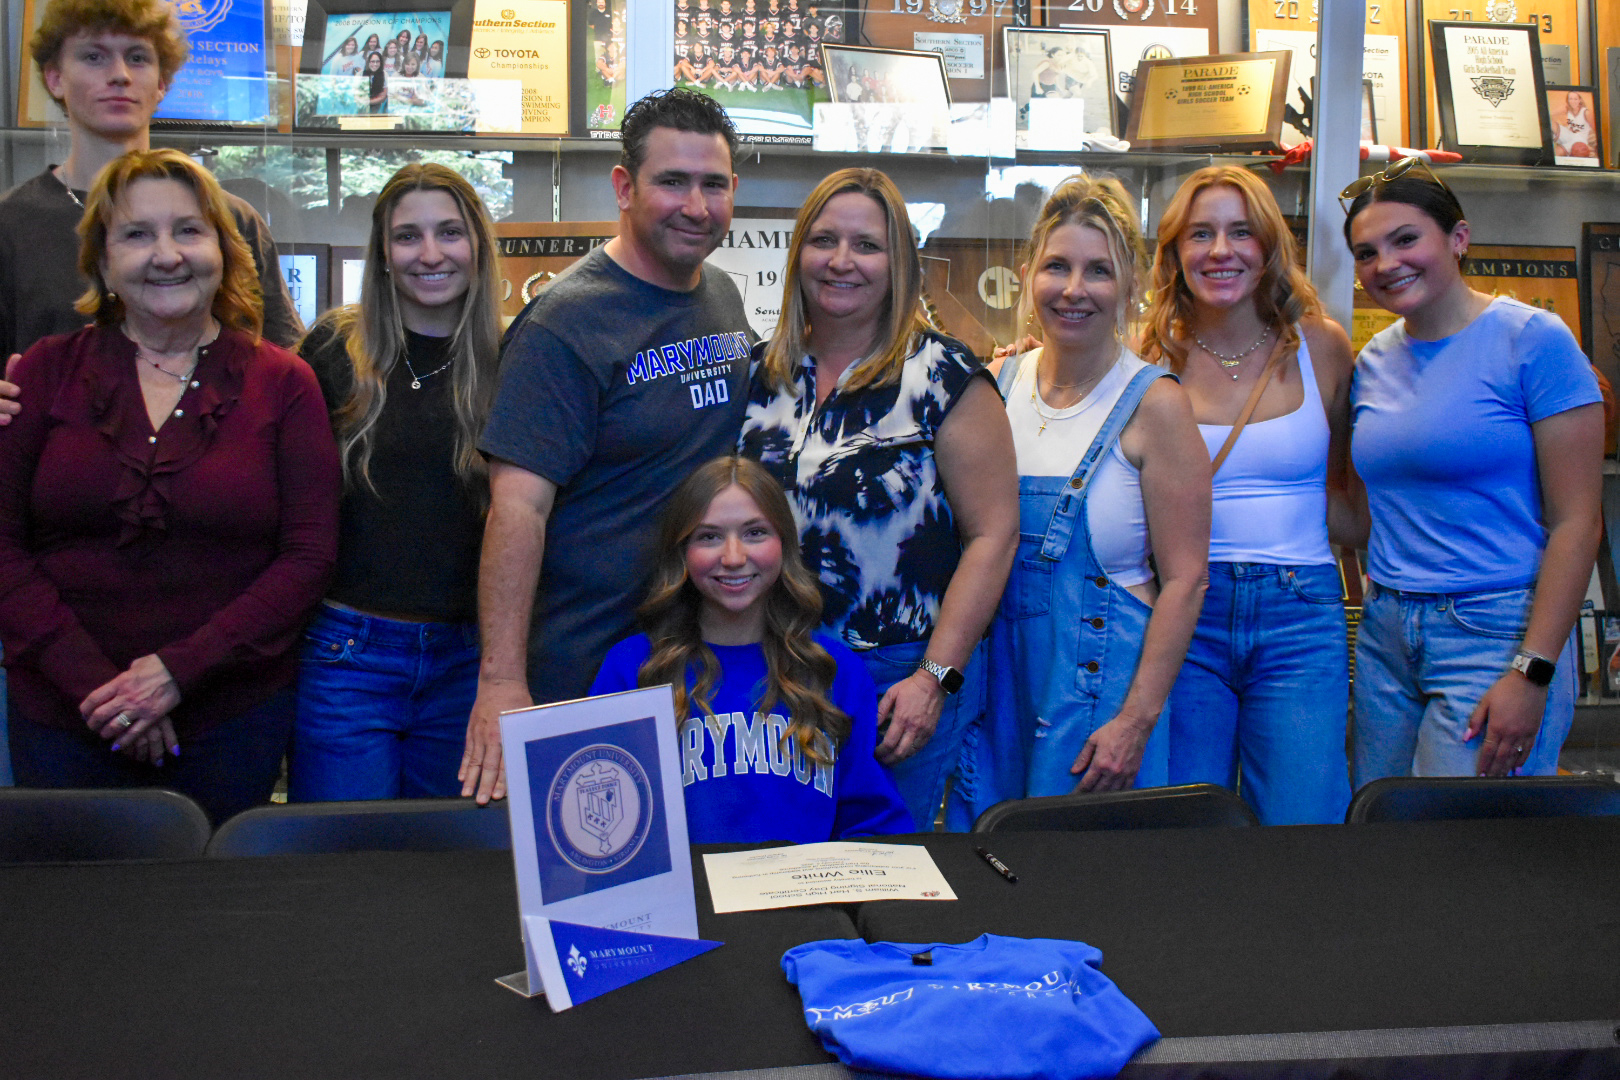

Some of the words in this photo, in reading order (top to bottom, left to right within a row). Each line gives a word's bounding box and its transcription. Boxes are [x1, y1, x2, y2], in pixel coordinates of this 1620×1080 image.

[474, 19, 512, 27] uthern
[513, 20, 556, 28] Section
[1464, 35, 1510, 45] PARADE
[198, 41, 259, 53] SECTION
[494, 49, 540, 59] TOYOTA
[490, 61, 550, 70] Championships
[1183, 66, 1239, 78] PARADE
[495, 238, 612, 255] RUNNER-U
[1466, 262, 1569, 277] AMPIONS
[626, 331, 752, 385] MARYMOUNT
[681, 364, 732, 384] UNIVERSITY
[689, 378, 729, 409] DAD
[682, 711, 836, 798] RYMOUN
[791, 871, 844, 880] White
[759, 888, 807, 896] Certificate
[589, 944, 653, 959] MARYMOUNT
